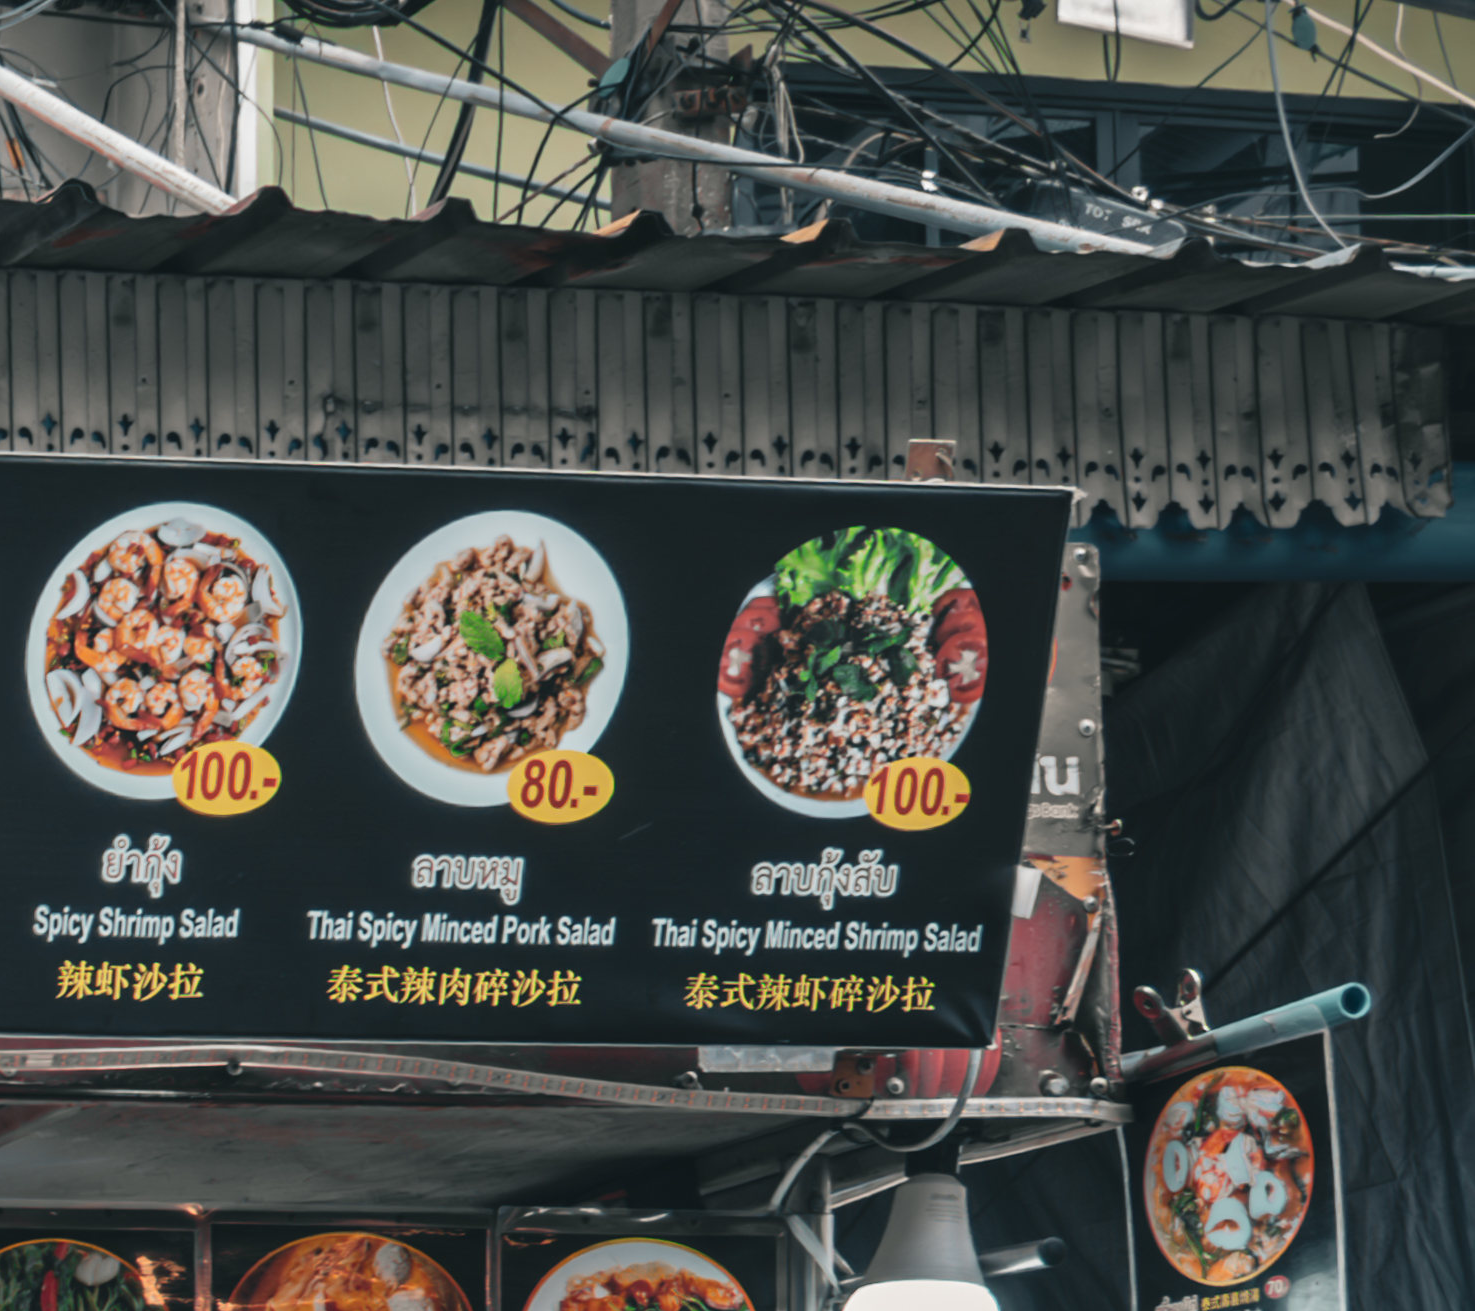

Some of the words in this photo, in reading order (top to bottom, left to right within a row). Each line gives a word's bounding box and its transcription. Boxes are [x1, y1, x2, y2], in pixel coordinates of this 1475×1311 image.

[102, 833, 183, 898] ยำกุ้ง
[412, 854, 525, 905] ลาบหมู
[33, 905, 94, 943] Spicy
[98, 907, 175, 945] Shrimp
[179, 908, 240, 938] Salad
[307, 910, 354, 940] Thai
[358, 911, 418, 949] Spicy
[421, 913, 498, 943] Minced
[502, 915, 552, 944] Pork
[556, 916, 616, 945] Salad
[652, 918, 698, 947] Thai
[702, 919, 761, 956] Spicy
[764, 920, 841, 950] Minced
[844, 921, 919, 958] Shrimp
[924, 923, 982, 952] Salad
[56, 960, 204, 1001] 辣虾沙拉
[327, 965, 582, 1007] 泰式辣肉碎沙拉
[684, 972, 935, 1012] 泰式辣虾碎沙拉
